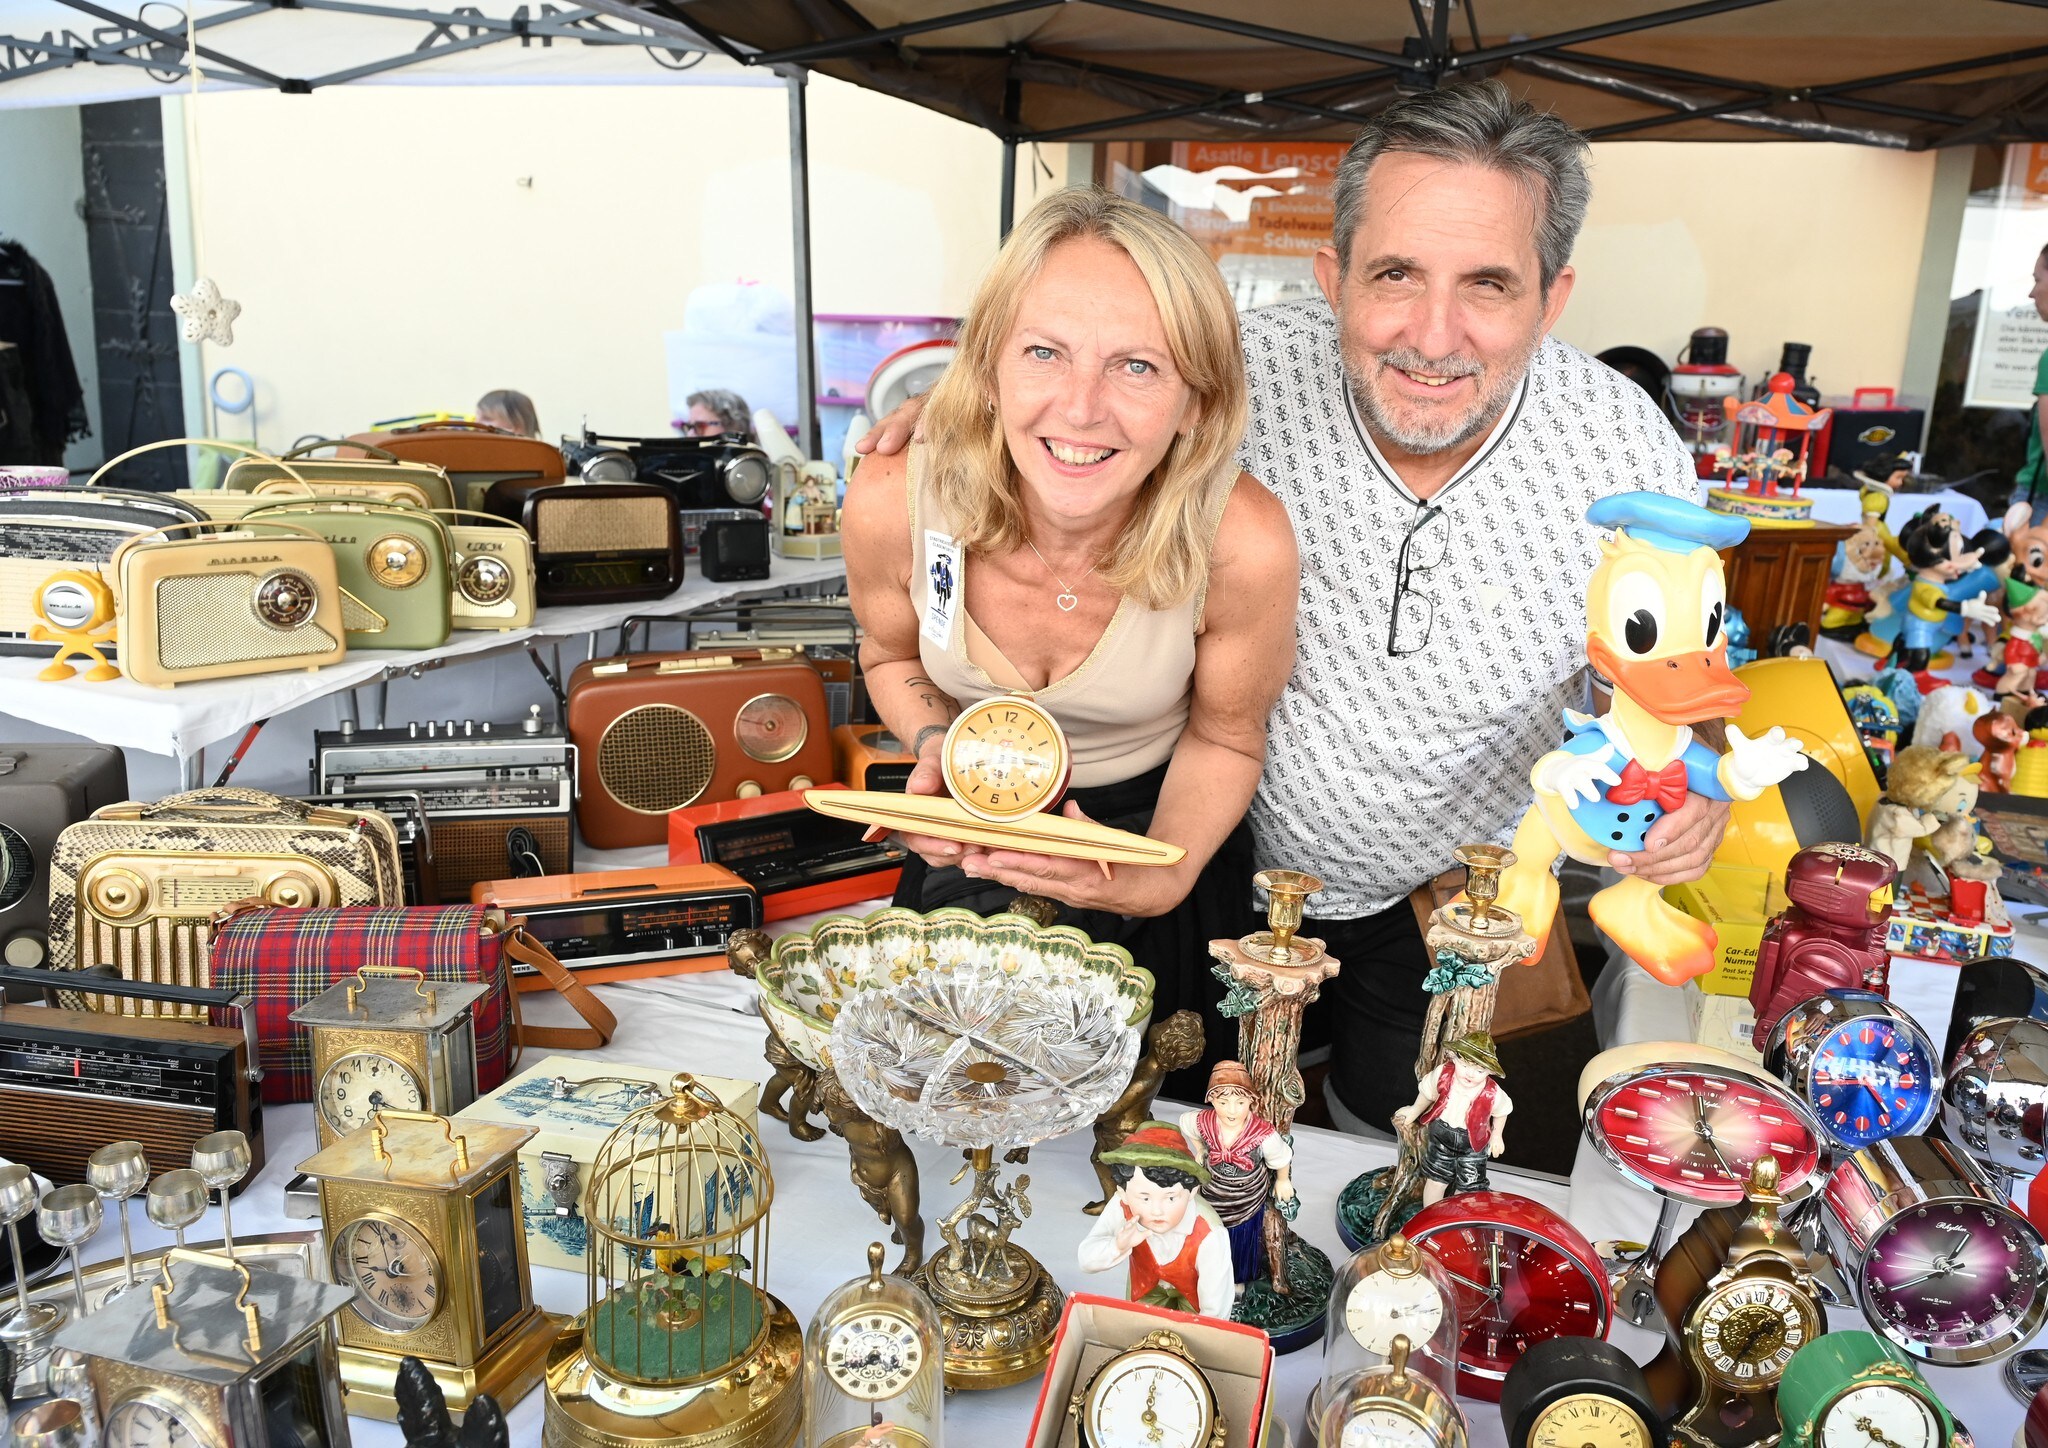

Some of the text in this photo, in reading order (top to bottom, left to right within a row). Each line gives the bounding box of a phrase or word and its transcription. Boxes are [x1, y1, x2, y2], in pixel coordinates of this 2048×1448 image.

[1006, 711, 1018, 723] 12
[990, 793, 1000, 804] 6
[1725, 946, 1759, 957] Car-Edi
[351, 1059, 362, 1072] 11
[339, 1071, 352, 1084] 10
[337, 1088, 347, 1100] 9
[408, 1089, 418, 1103] 3
[343, 1105, 353, 1117] 8
[1935, 1221, 1968, 1233] Rhythm
[1732, 1293, 1744, 1307] XI
[1753, 1291, 1766, 1304] XII
[1713, 1307, 1726, 1318] X
[1785, 1314, 1798, 1323] II
[1704, 1325, 1718, 1335] IX
[1786, 1333, 1800, 1341] III
[1776, 1347, 1791, 1361] IIII
[1740, 1364, 1750, 1376] VI
[1387, 1417, 1398, 1429] 12
